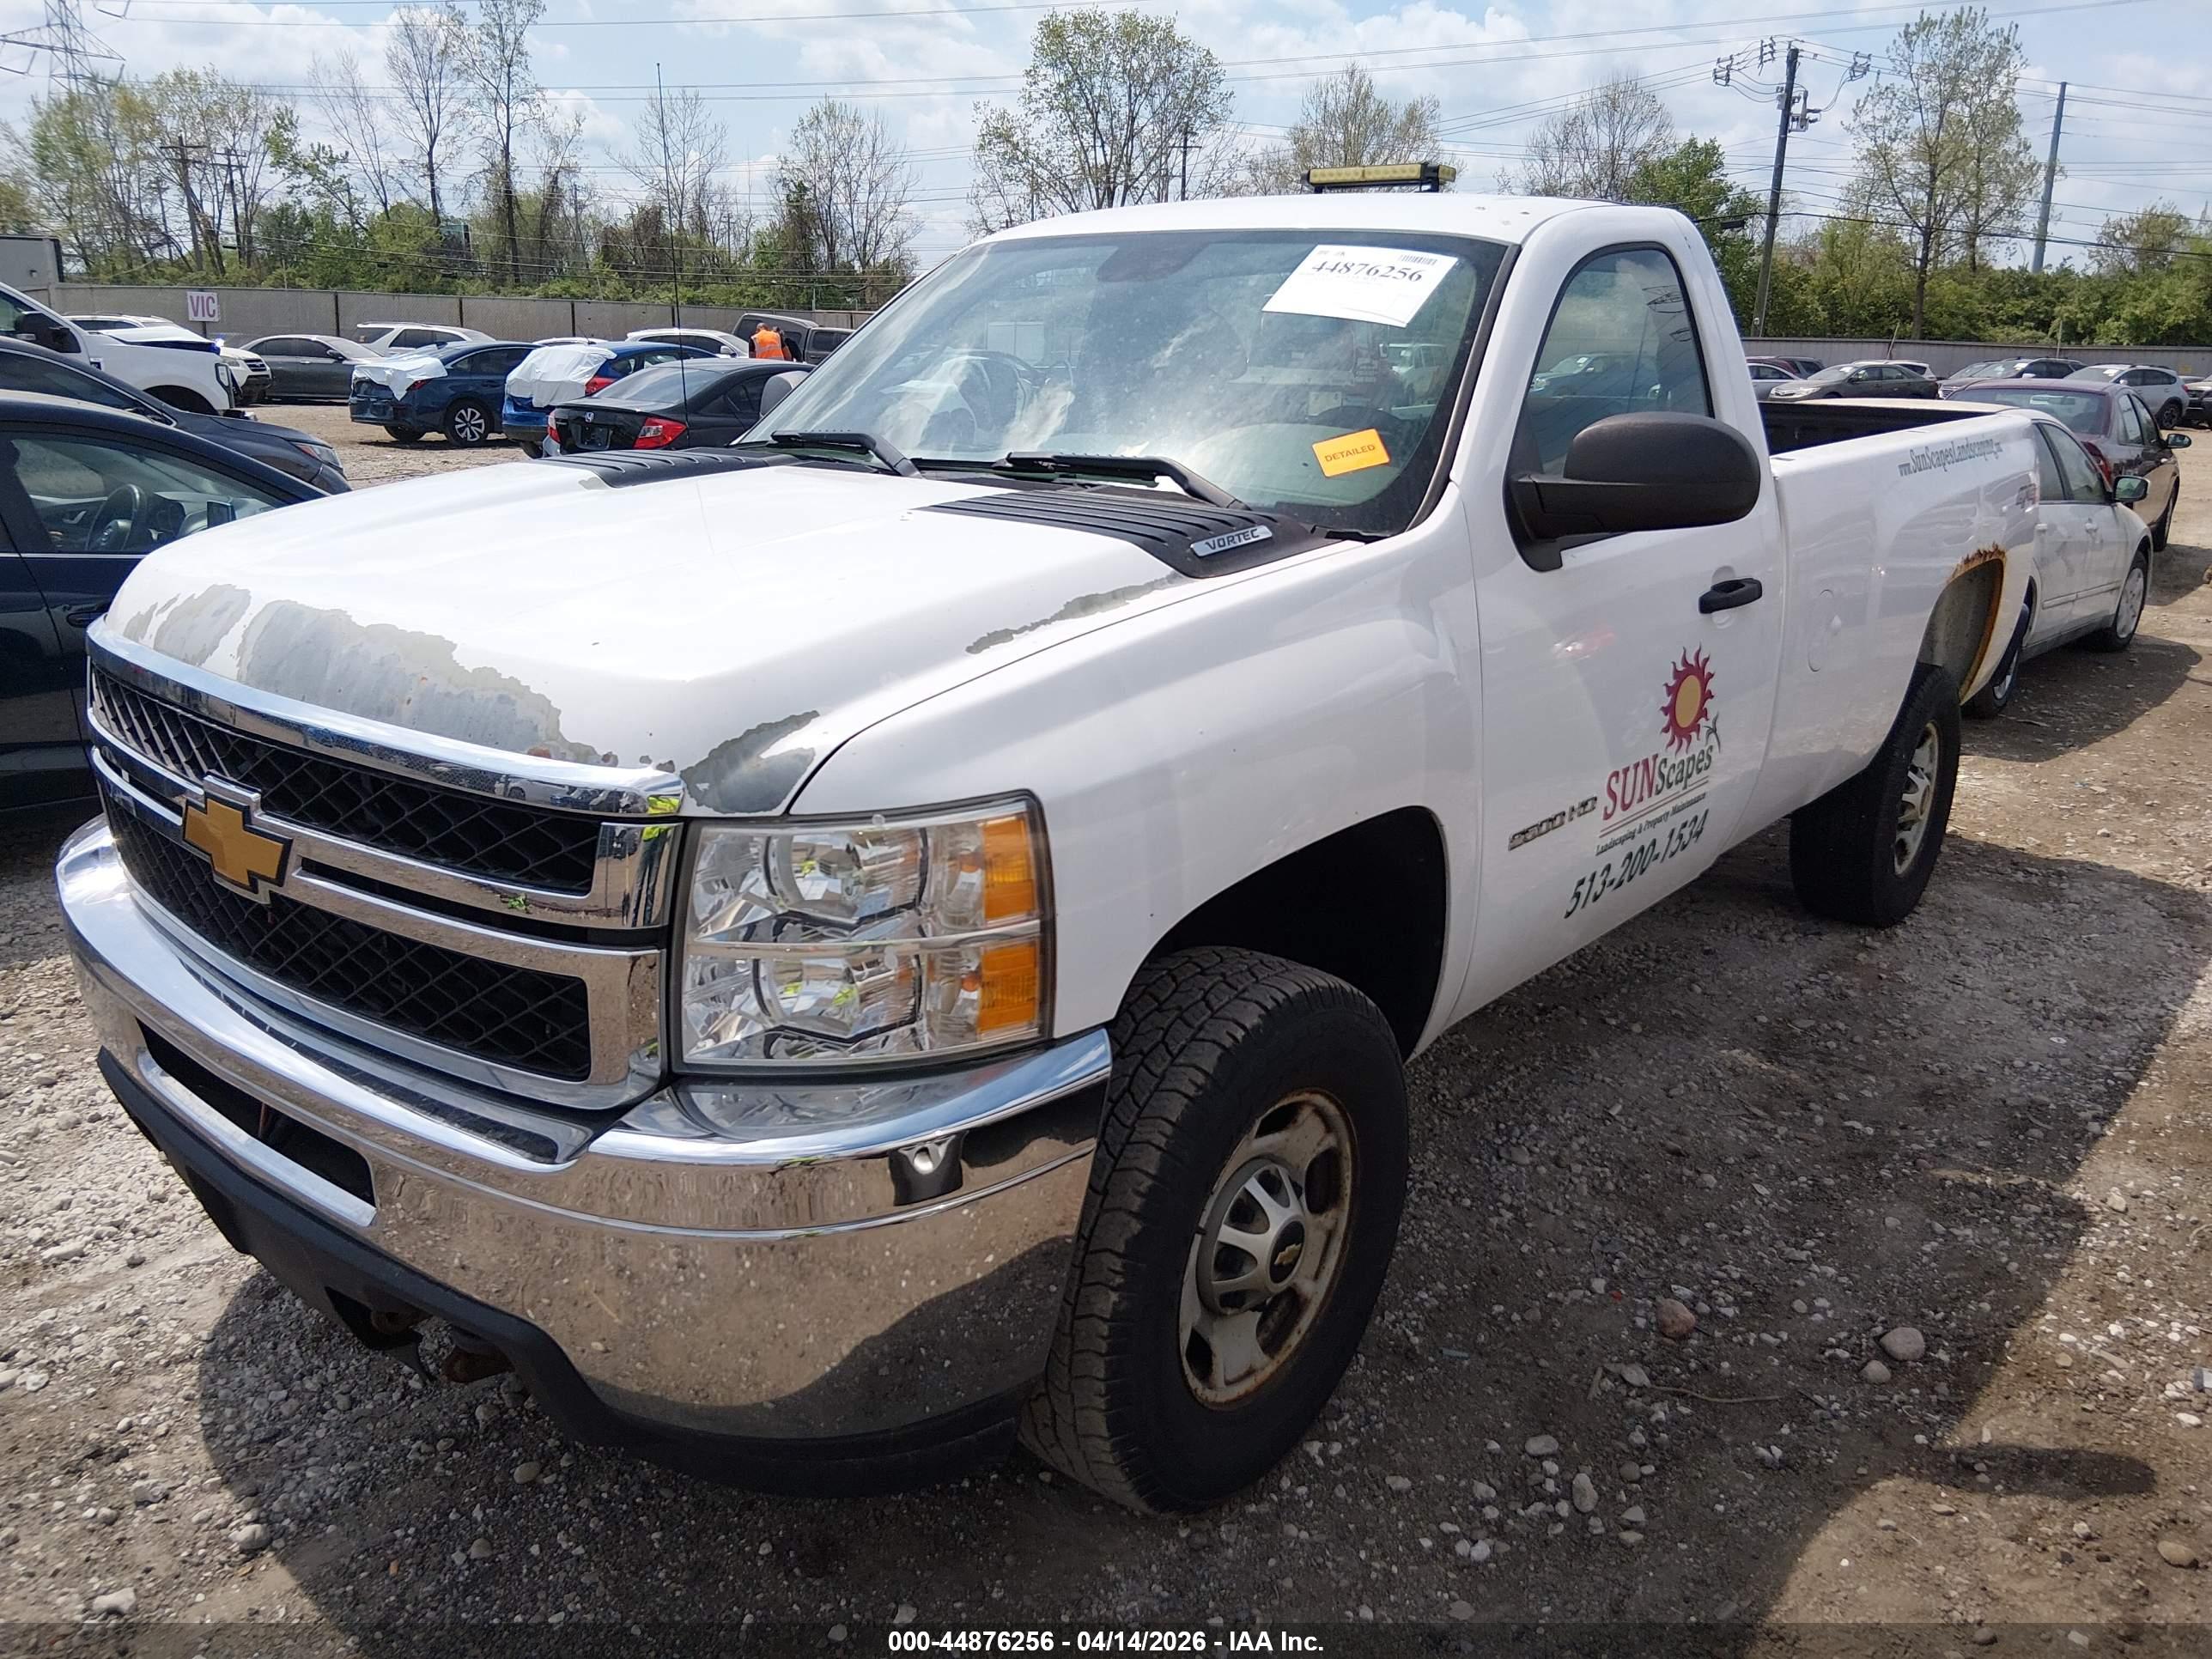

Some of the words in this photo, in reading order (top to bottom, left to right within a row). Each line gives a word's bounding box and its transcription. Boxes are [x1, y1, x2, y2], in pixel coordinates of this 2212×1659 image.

[1312, 260, 1424, 283] 44876256
[190, 295, 216, 318] VIC
[1324, 444, 1376, 462] DETAILED
[1205, 528, 1260, 550] VORTEC
[1595, 829, 1636, 856] Landscaping
[1637, 823, 1643, 835] &
[1644, 811, 1669, 831] Property
[1564, 808, 1709, 919] 513-200-1534
